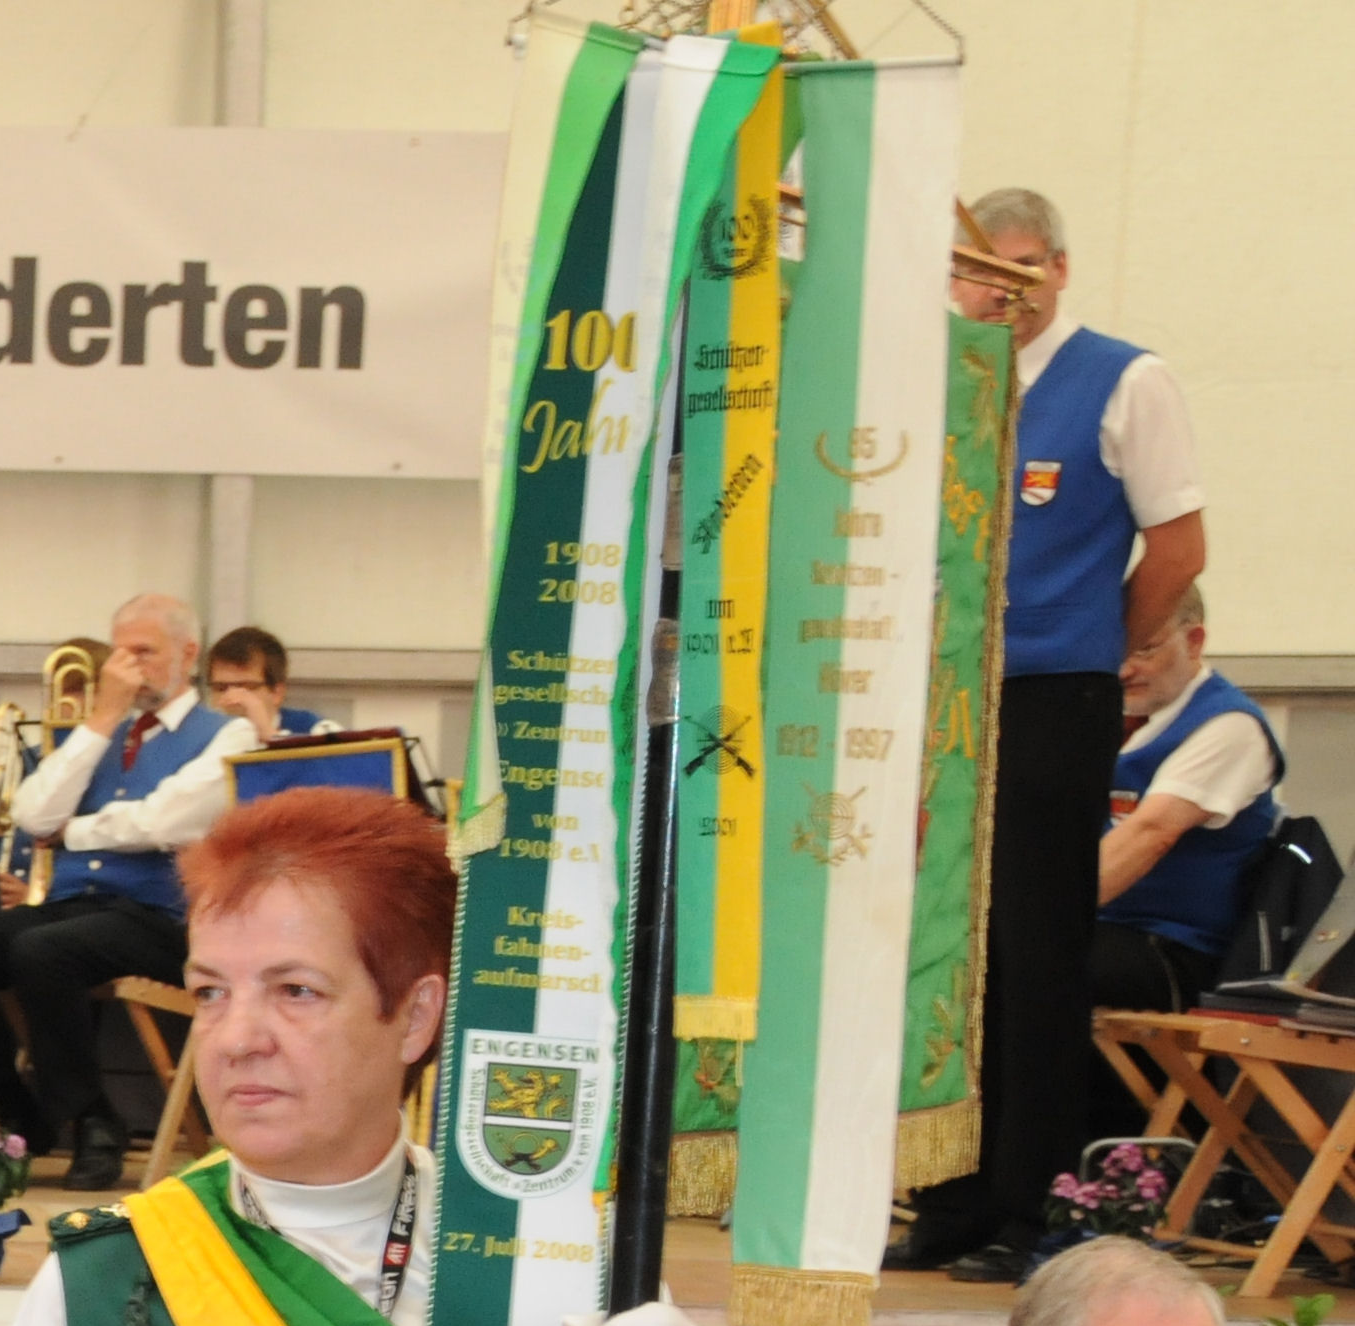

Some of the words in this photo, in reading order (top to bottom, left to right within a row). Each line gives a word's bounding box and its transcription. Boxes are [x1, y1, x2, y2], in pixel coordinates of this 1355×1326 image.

[545, 541, 623, 568] 1908
[538, 578, 618, 605] 2008
[531, 813, 579, 831] von
[499, 837, 563, 861] 1908
[507, 905, 583, 930] Kreis-
[494, 935, 591, 961] fahnen-
[472, 1037, 600, 1063] ENGENSEN
[443, 1231, 481, 1253] 27.
[483, 1235, 527, 1258] Juli
[532, 1239, 595, 1264] 2008
